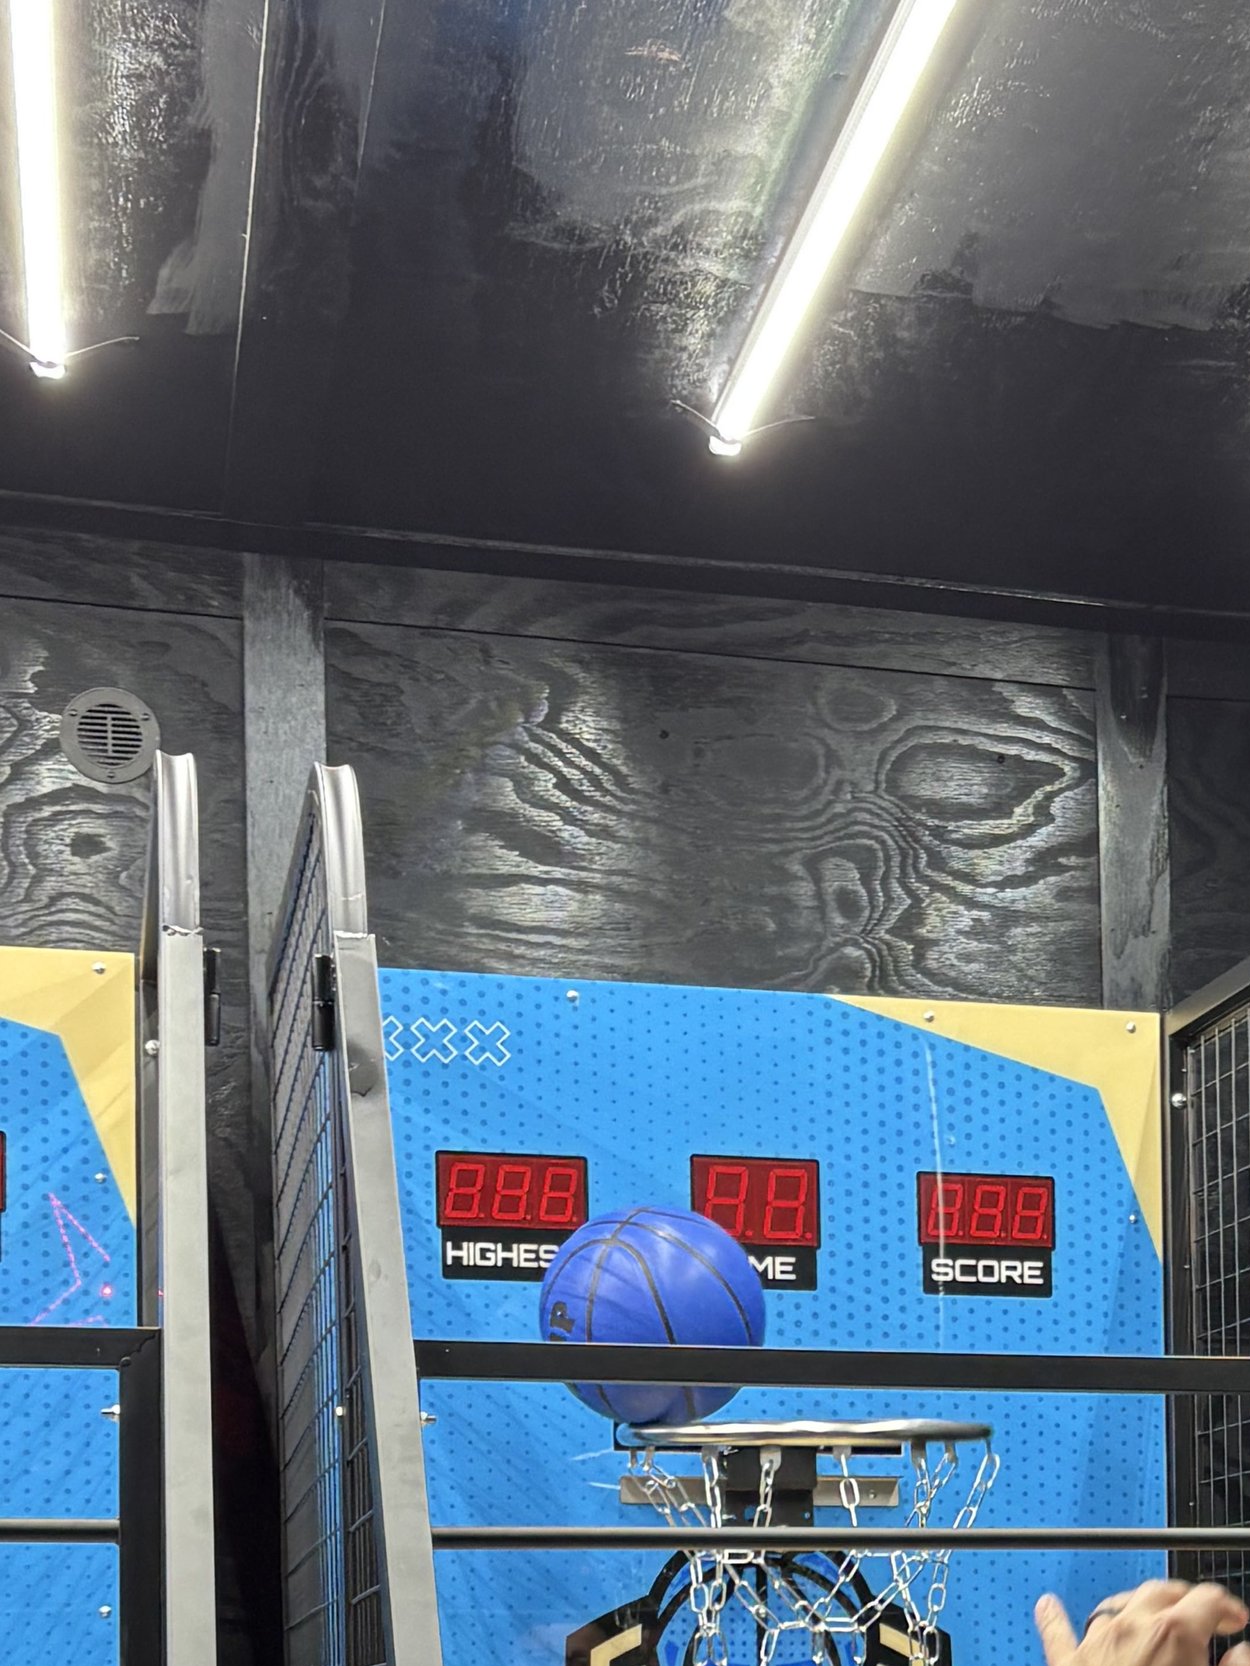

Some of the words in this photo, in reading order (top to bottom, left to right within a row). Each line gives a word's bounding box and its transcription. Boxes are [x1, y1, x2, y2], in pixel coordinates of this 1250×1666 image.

[446, 1241, 560, 1268] HIGHES
[748, 1256, 797, 1280] ME
[931, 1258, 1044, 1285] SCORE
